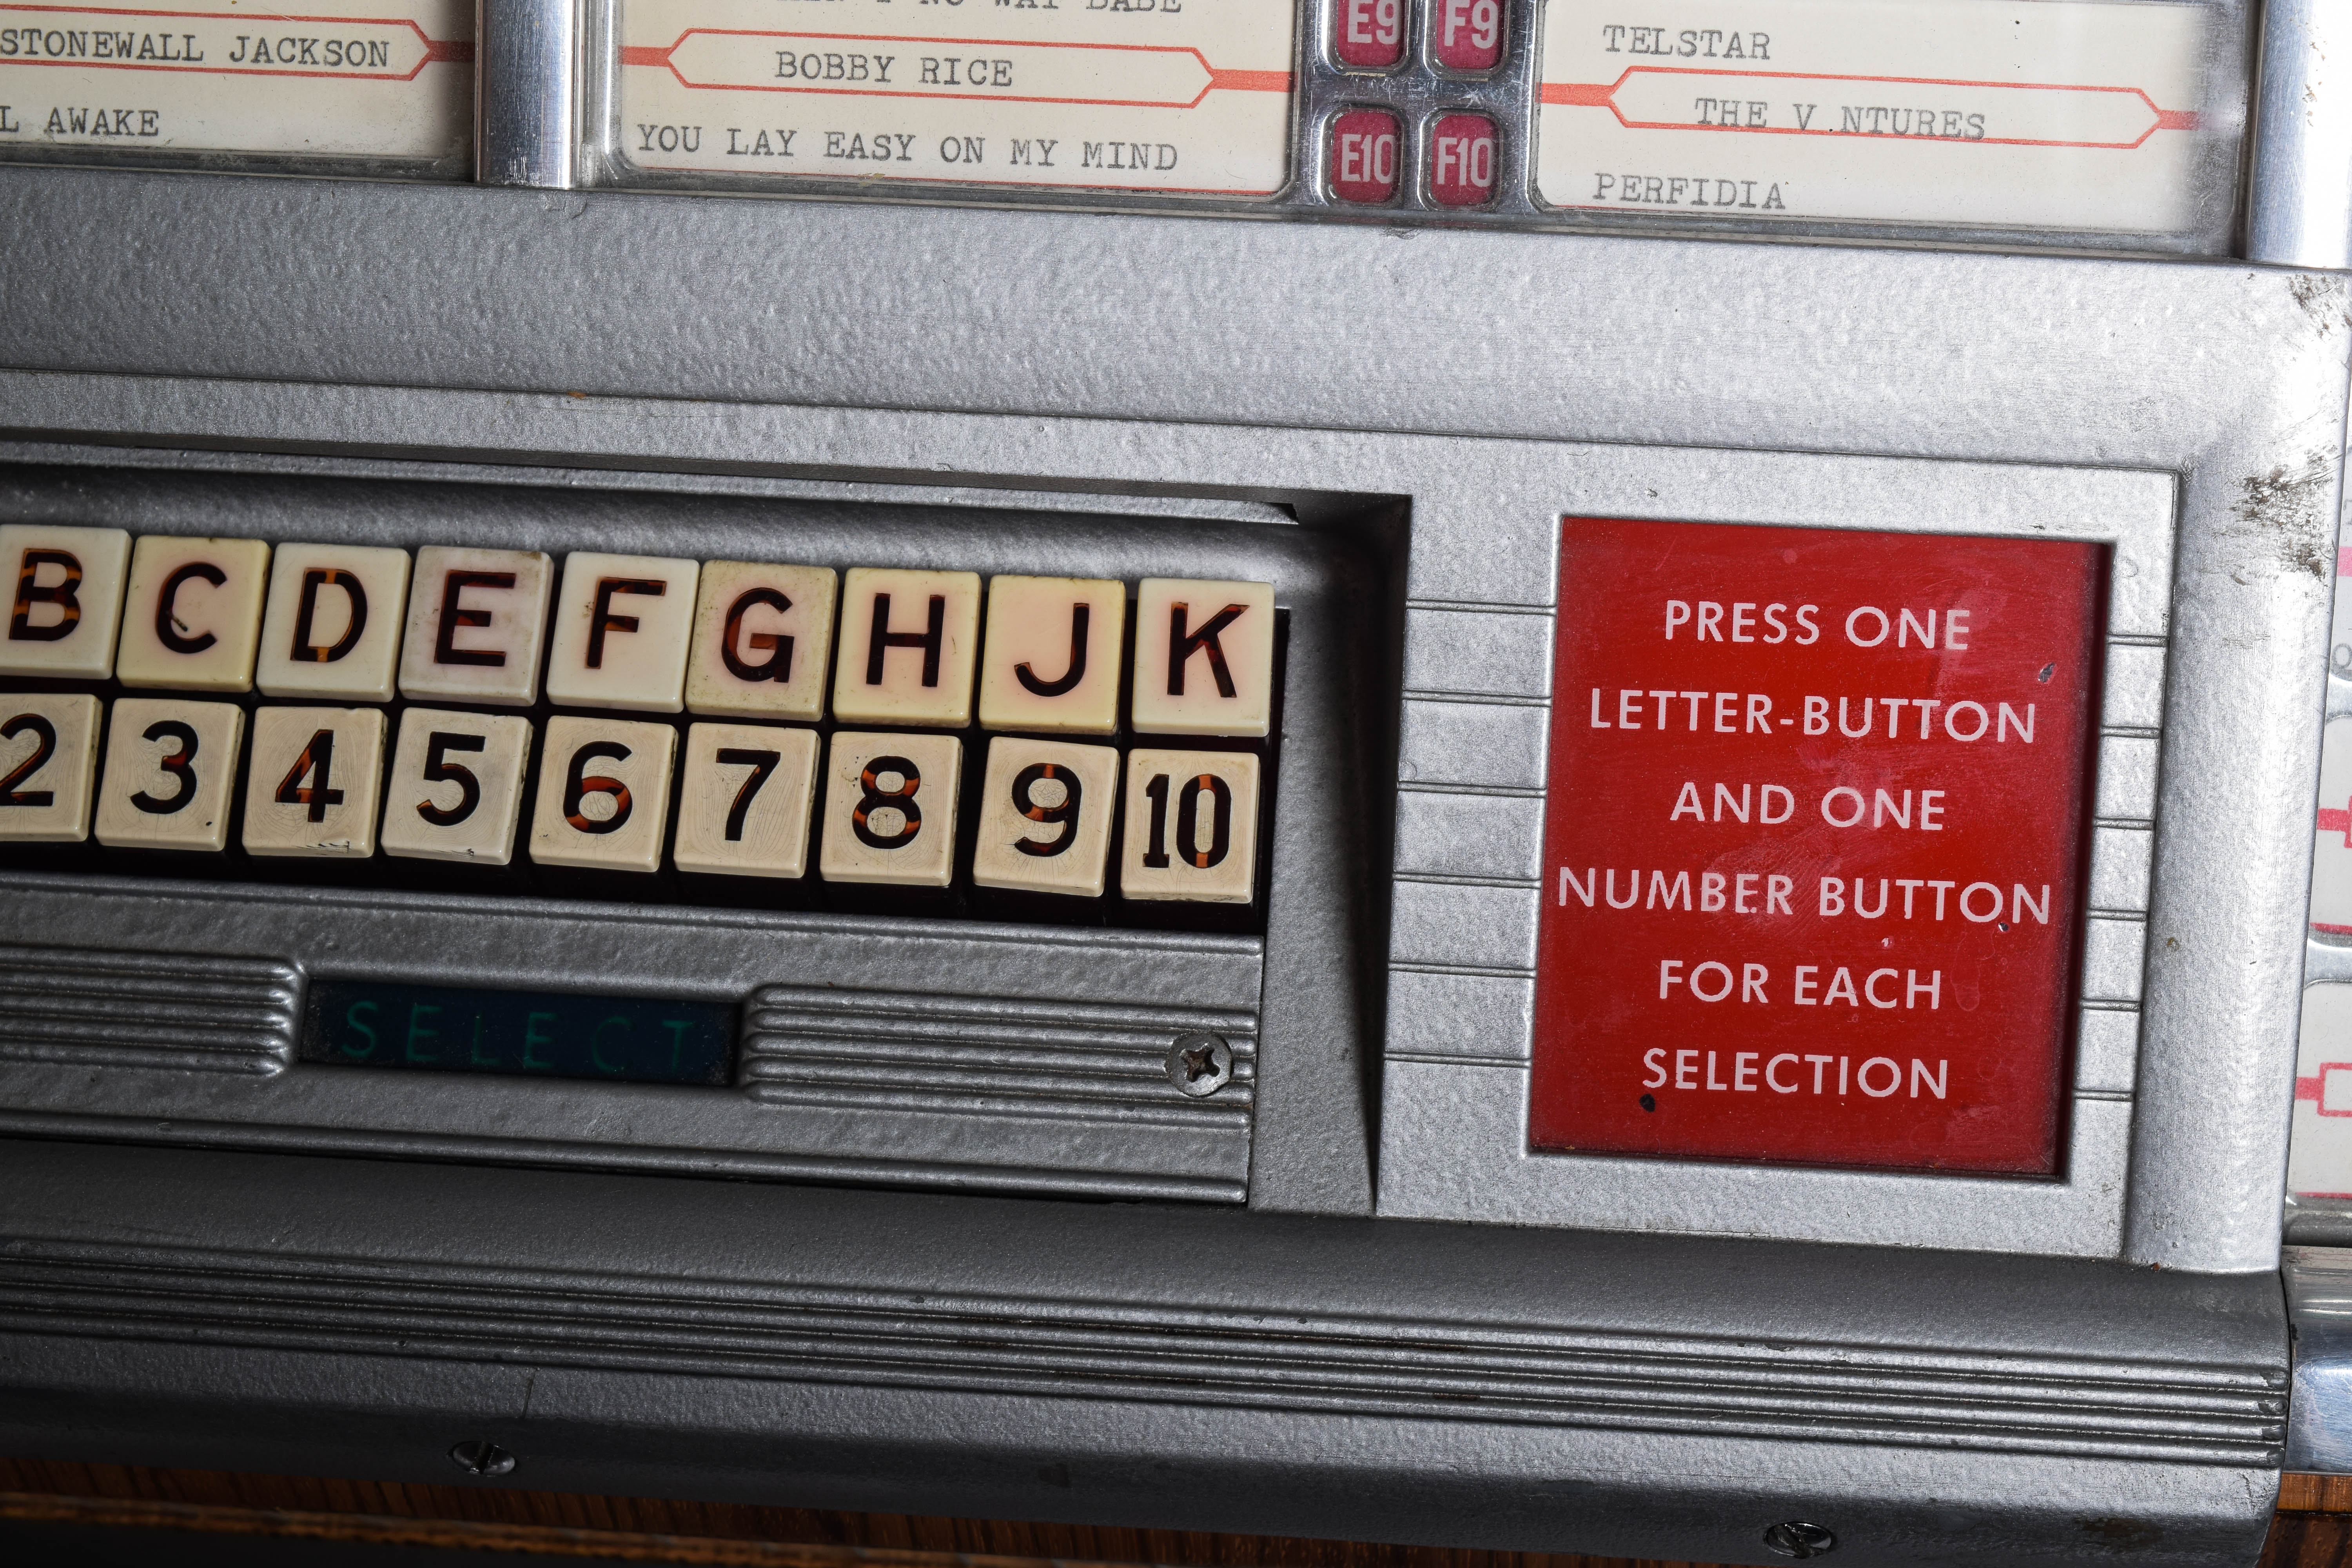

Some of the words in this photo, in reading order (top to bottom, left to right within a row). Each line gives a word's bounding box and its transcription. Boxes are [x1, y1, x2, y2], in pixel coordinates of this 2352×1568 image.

[0, 28, 203, 61] STONEWALL
[229, 36, 389, 67] JACKSON
[1348, 0, 1399, 45] E9
[1444, 0, 1498, 49] F9
[1603, 25, 1770, 60] TELSTAR
[775, 51, 895, 83] BOBBY
[920, 58, 1012, 87] RICE
[44, 107, 159, 136] AWAKE
[637, 124, 702, 152] YOU
[726, 128, 797, 156] LAY
[824, 132, 916, 161] EASY
[940, 136, 985, 163] ON
[1010, 139, 1058, 166] MY
[1082, 142, 1177, 170] MIND
[1695, 98, 1767, 127] THE
[1341, 134, 1394, 183] E10
[1437, 137, 1489, 187] F10
[1594, 173, 1785, 210] PERFIDIA
[9, 548, 82, 642] B
[155, 562, 227, 654] C
[290, 569, 367, 662] D
[434, 570, 516, 667] E
[587, 577, 665, 669] F
[721, 588, 794, 683] G
[1666, 600, 1819, 644] PRESS
[1846, 606, 1970, 650] ONE
[866, 593, 945, 687] H
[1014, 603, 1089, 697] J
[1167, 602, 1248, 697] K
[1592, 688, 2035, 743] LETTER-BUTTON
[0, 713, 56, 807] 2
[130, 720, 198, 814] 3
[275, 729, 344, 823] 4
[417, 731, 486, 826] 5
[563, 741, 632, 834] 6
[716, 748, 780, 841] 7
[852, 756, 921, 849] 8
[1011, 763, 1082, 857] 9
[1143, 774, 1231, 868] 10
[1670, 782, 1794, 824] AND
[1822, 786, 1945, 830] ONE
[1559, 867, 1793, 915] NUMBER
[1820, 877, 2049, 924] BUTTON
[1660, 960, 1768, 1003] FOR
[1795, 966, 1940, 1009] EACH
[341, 1001, 695, 1073] SELECT
[1643, 1048, 1947, 1099] SELECTION
